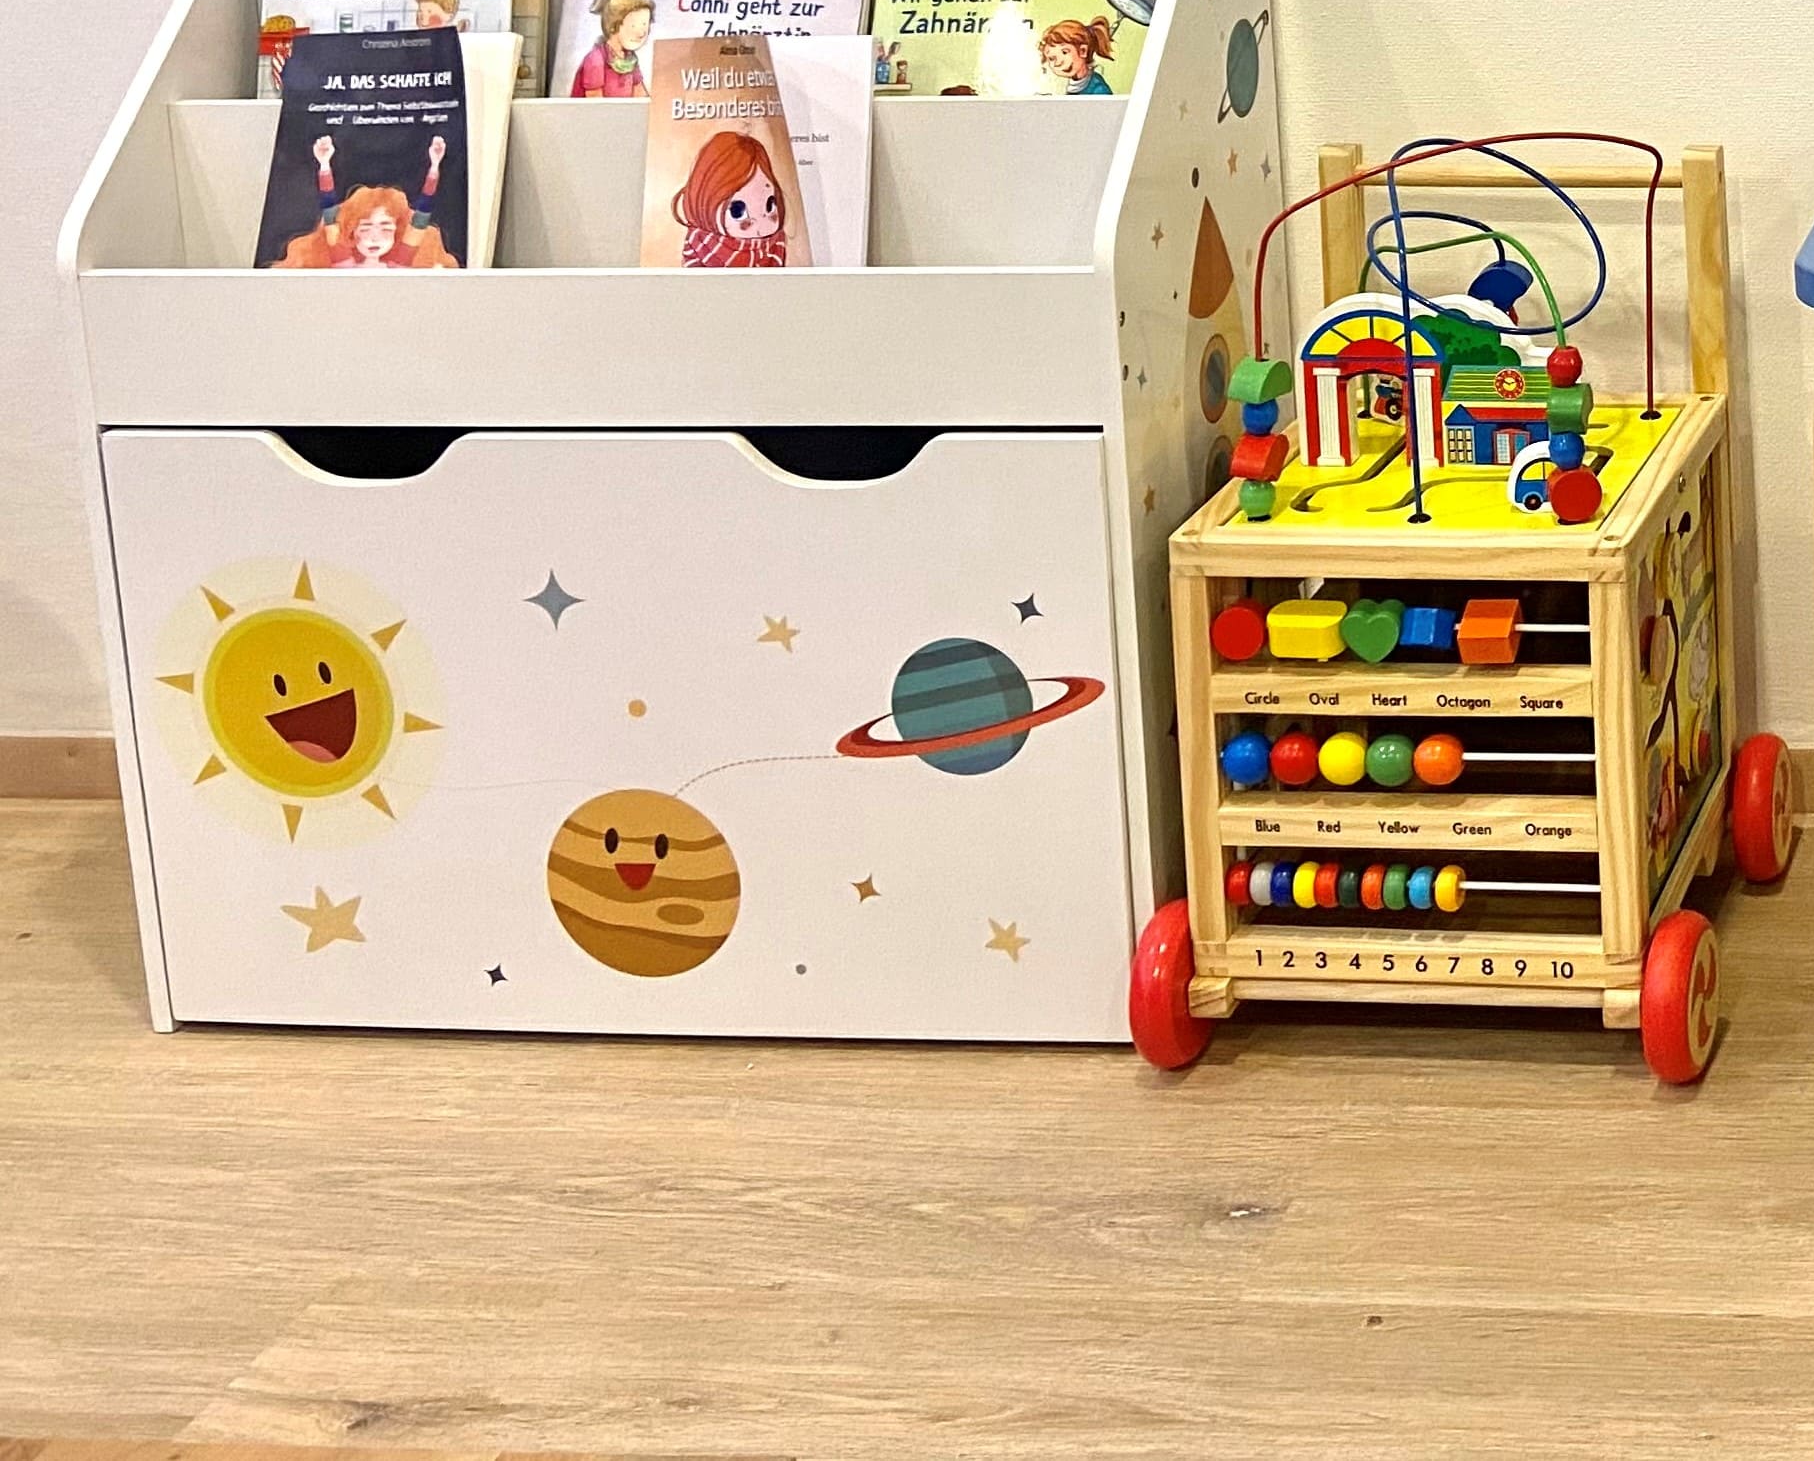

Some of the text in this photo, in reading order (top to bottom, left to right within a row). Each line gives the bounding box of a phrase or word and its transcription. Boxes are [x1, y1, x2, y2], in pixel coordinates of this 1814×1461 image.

[789, 3, 824, 17] zur
[899, 11, 1034, 34] Zahnärn
[350, 75, 376, 89] DAS
[379, 73, 431, 89] SCHAFFE
[681, 67, 719, 90] Weil
[723, 67, 745, 88] du
[672, 95, 766, 120] Besonderes
[1244, 692, 1563, 712] Circle Oval Heart Octagon Square
[1255, 820, 1572, 840] Blue Red Yellow Green Orange
[1256, 950, 1574, 979] 1 2 3 4 5 6 7 8 9 10
